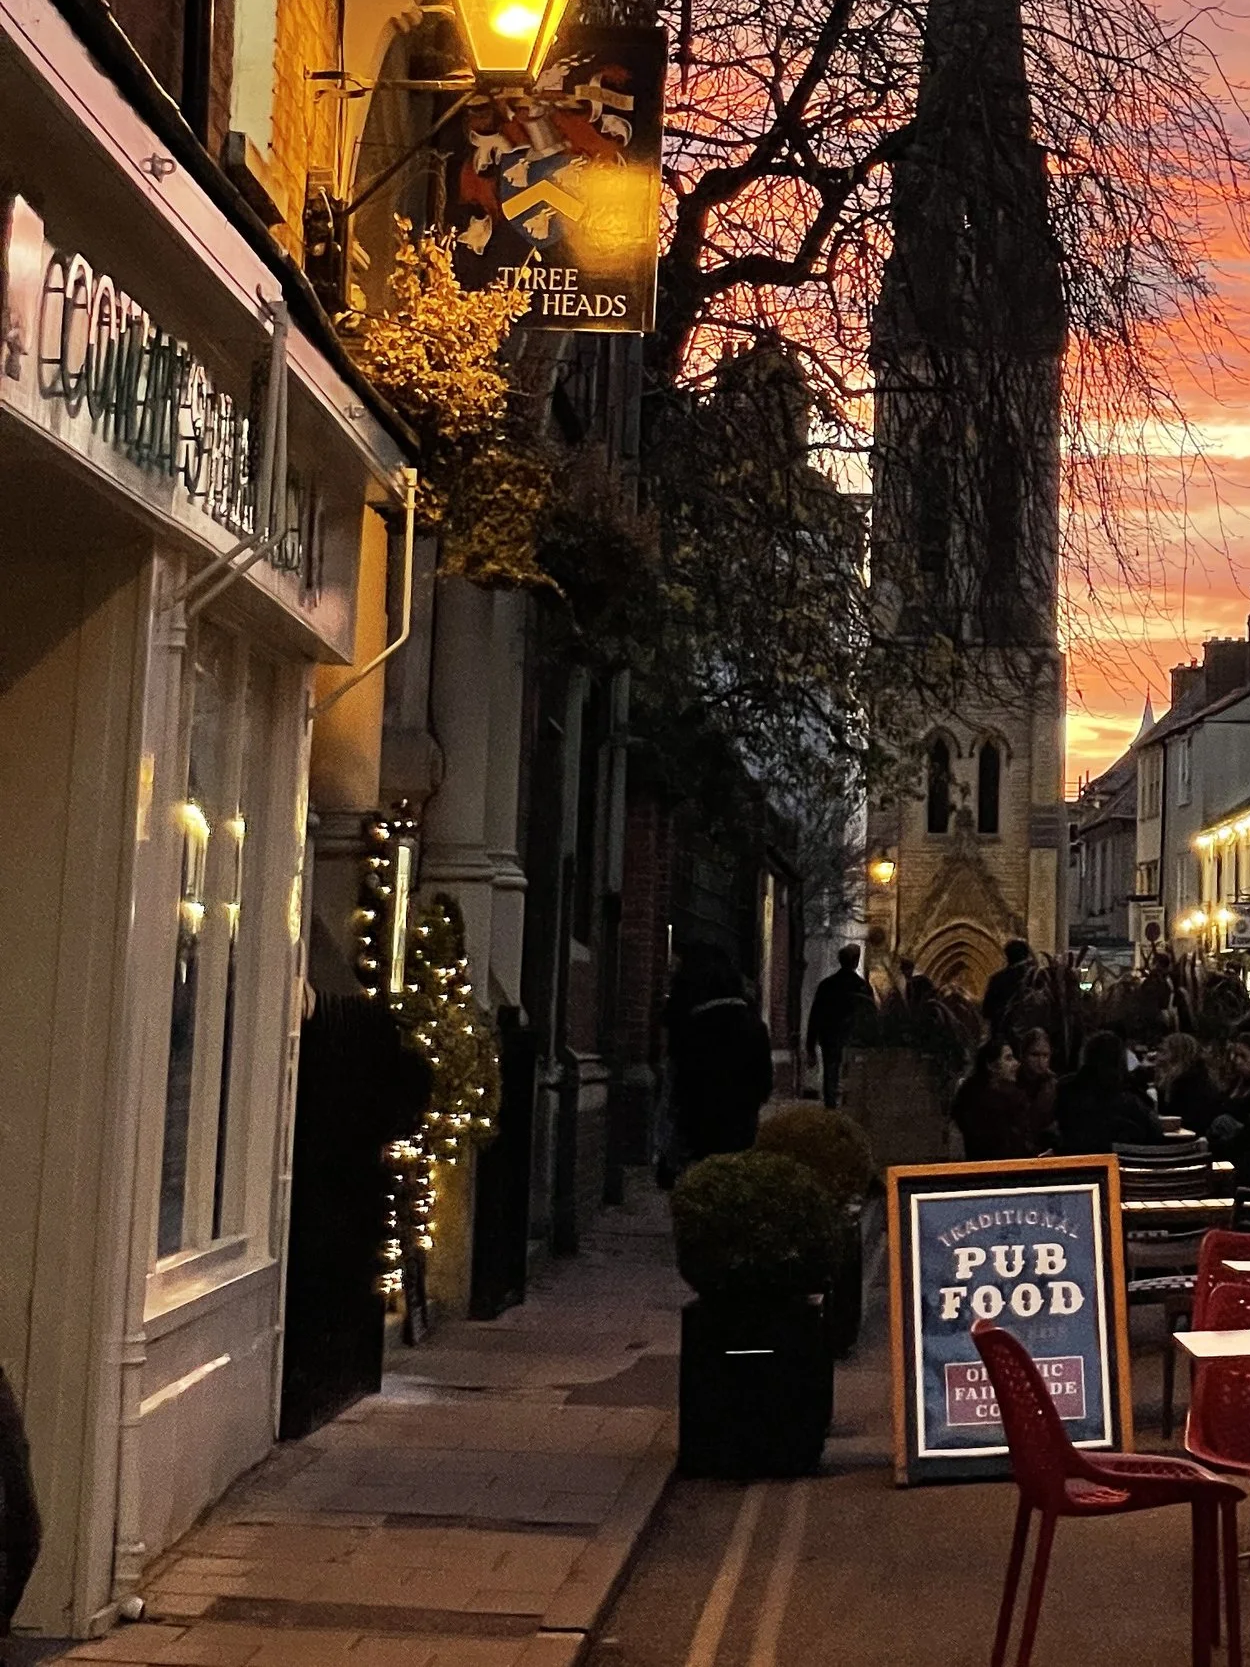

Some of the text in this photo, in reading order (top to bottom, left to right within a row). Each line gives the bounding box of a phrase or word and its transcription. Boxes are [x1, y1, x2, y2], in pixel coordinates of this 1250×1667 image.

[498, 267, 578, 291] THREE
[542, 293, 627, 317] HEADS
[953, 1242, 1067, 1279] PUB
[939, 1281, 1085, 1319] FOOD
